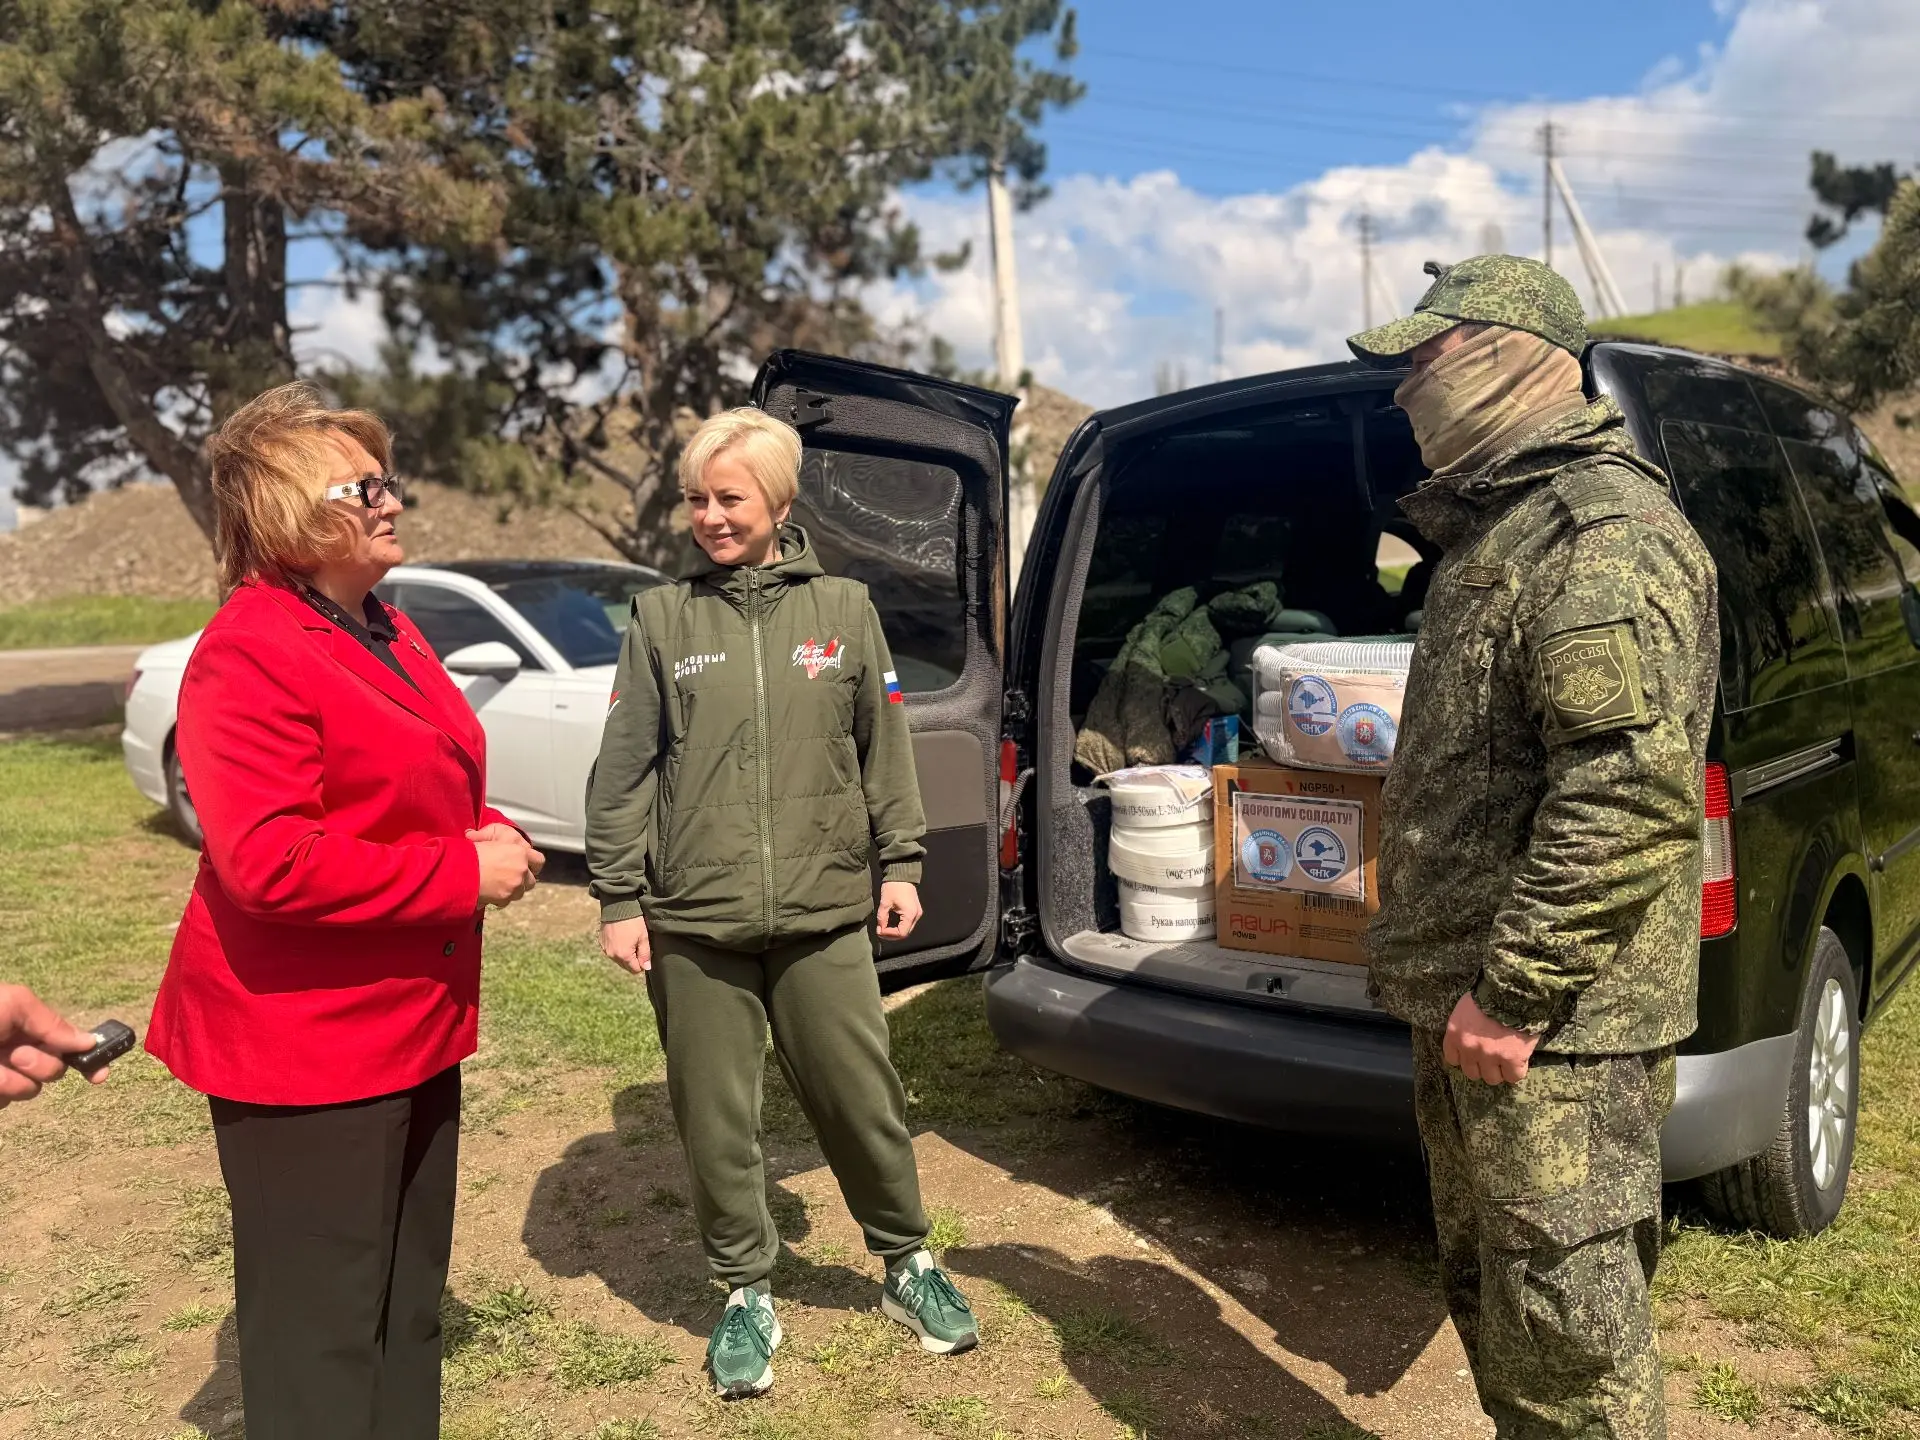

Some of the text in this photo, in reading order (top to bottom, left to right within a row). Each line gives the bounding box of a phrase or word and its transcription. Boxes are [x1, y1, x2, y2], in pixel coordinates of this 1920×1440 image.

[1552, 644, 1607, 668] РОССИЯ
[674, 663, 704, 680] ФРОНТ
[1300, 782, 1346, 795] NGP50-1
[1242, 803, 1353, 826] ДОРОГОМУ СОЛДАТУ!
[1151, 915, 1174, 928] Рукав
[1232, 930, 1257, 940] POWER
